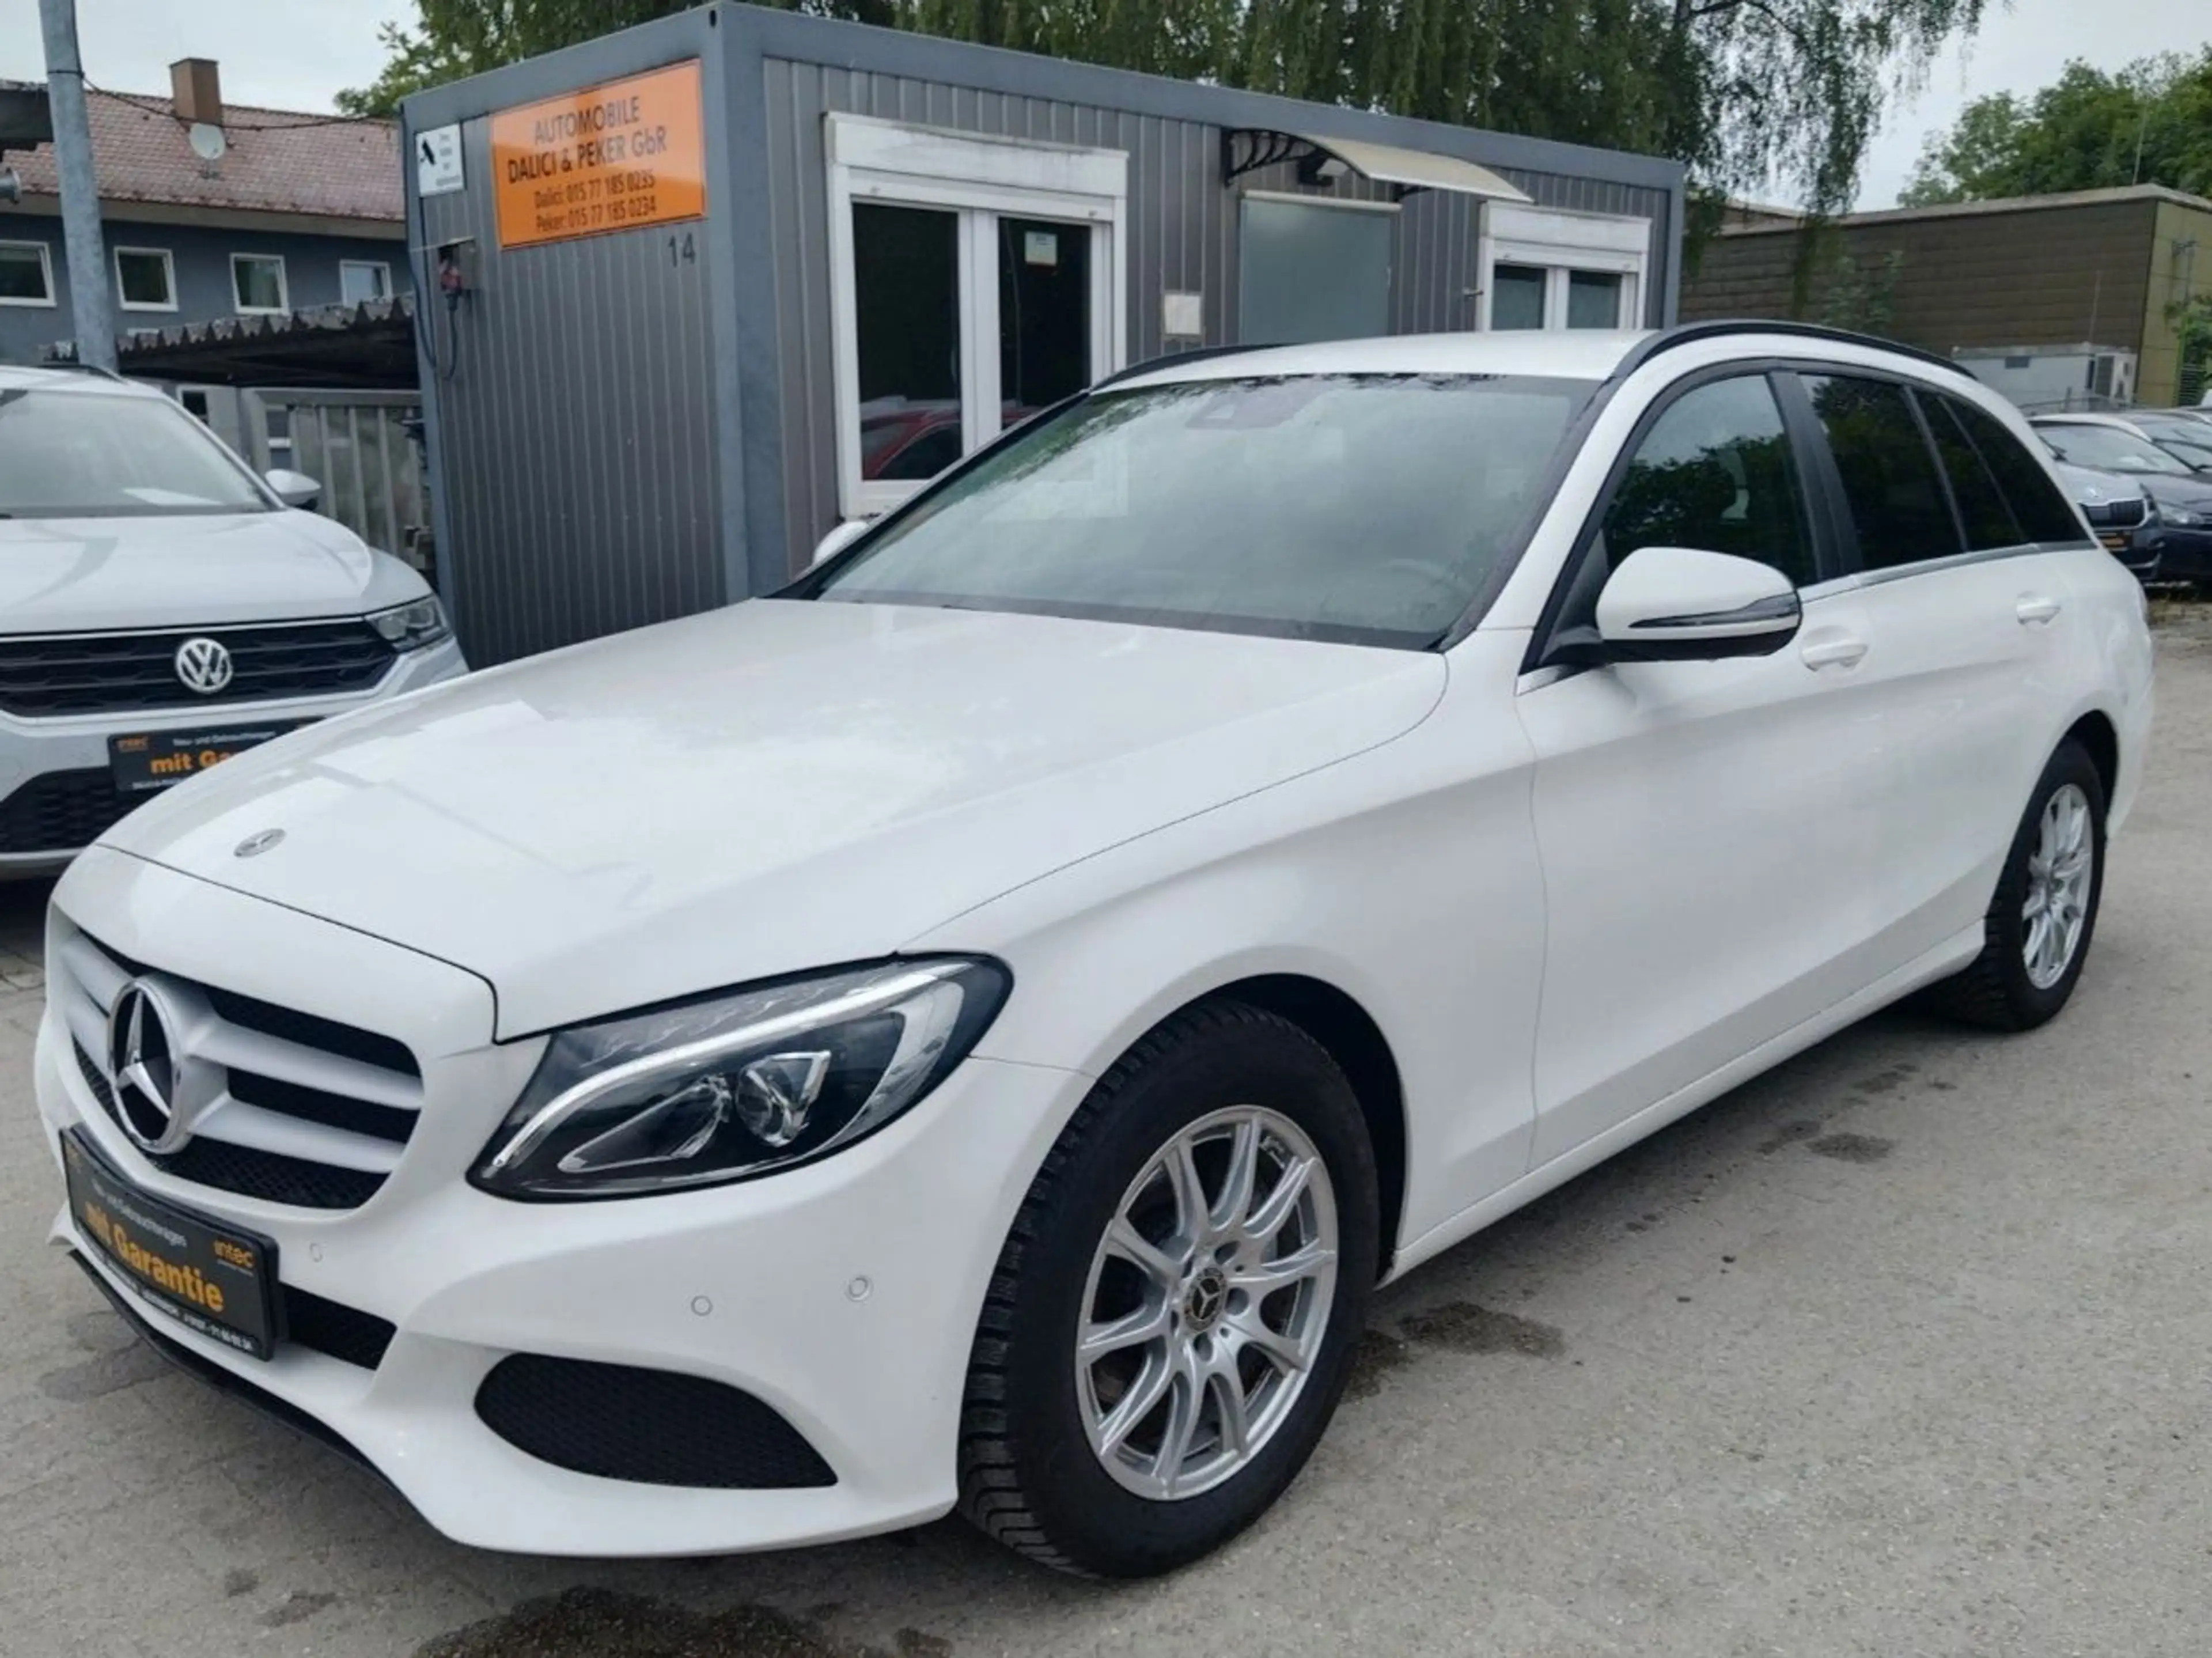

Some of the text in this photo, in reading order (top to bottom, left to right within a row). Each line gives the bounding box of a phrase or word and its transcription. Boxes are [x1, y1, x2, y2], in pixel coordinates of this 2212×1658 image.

[535, 96, 640, 145] AUTOMOBILE
[507, 125, 667, 185] DALICI & PEKER GbR
[588, 177, 601, 199] 77
[590, 203, 603, 224] 77
[668, 232, 696, 268] 14
[150, 752, 194, 774] mit
[85, 1201, 113, 1246] mit
[112, 1223, 225, 1312] Garantie
